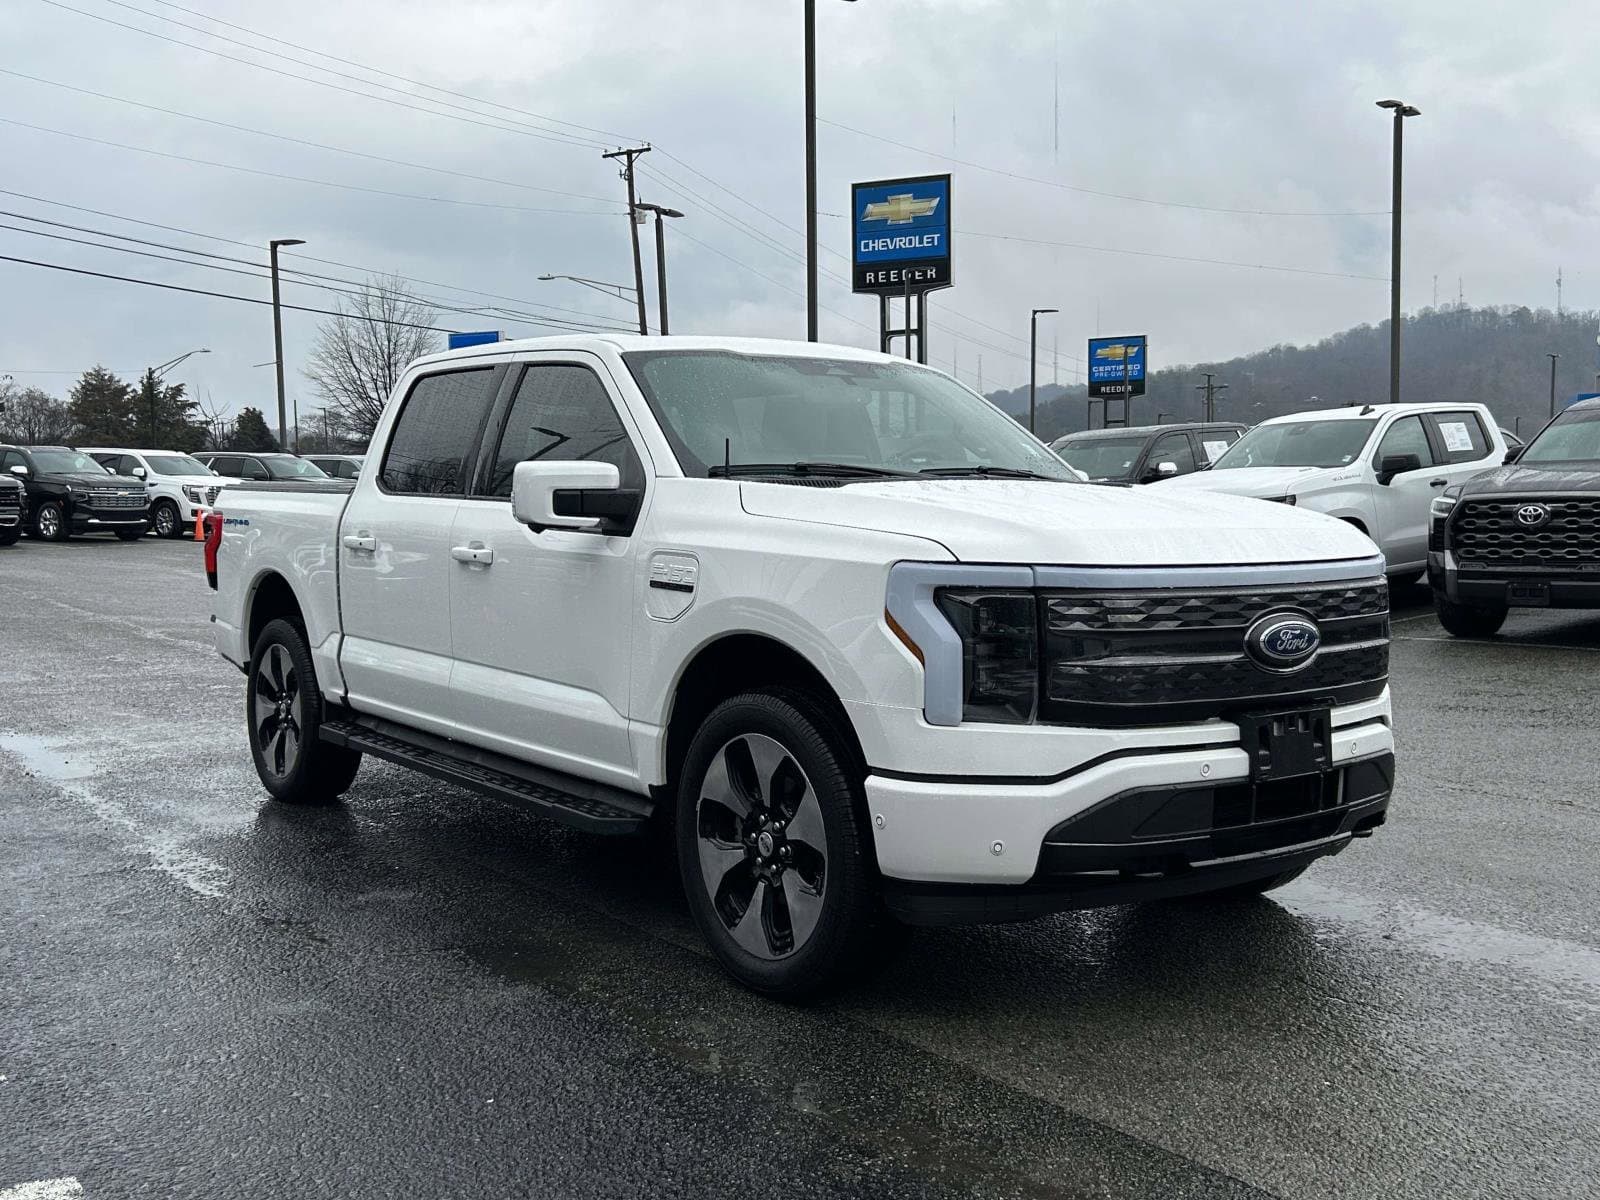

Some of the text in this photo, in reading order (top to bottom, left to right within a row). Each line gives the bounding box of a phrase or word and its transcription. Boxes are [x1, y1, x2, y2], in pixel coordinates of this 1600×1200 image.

[860, 234, 940, 252] CHEVROLET
[1092, 363, 1141, 373] CERTIFED
[1276, 629, 1309, 651] Ford
